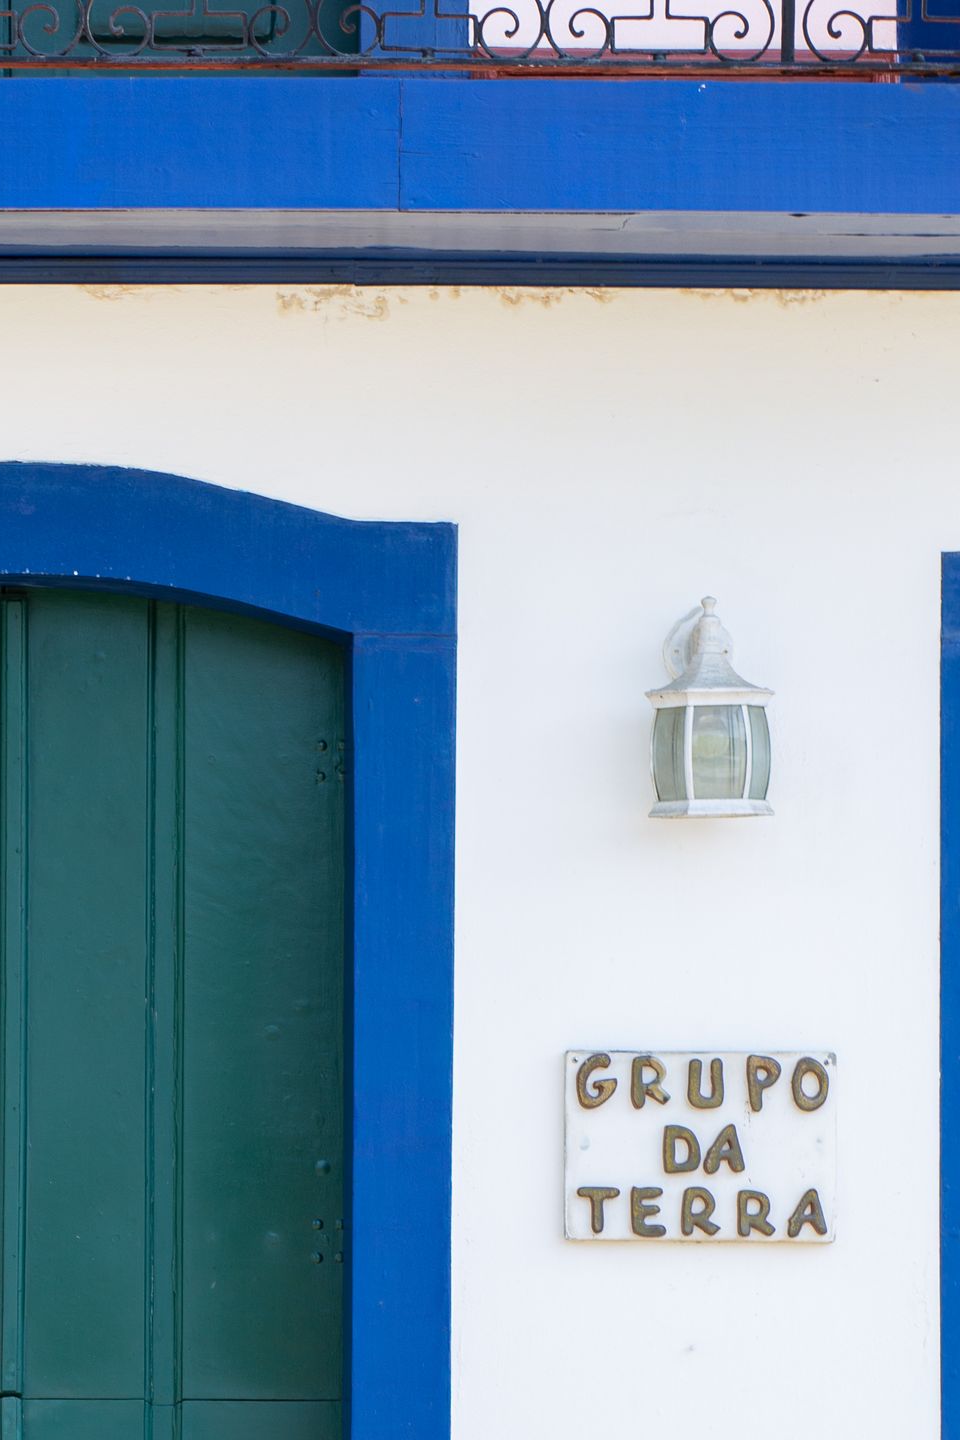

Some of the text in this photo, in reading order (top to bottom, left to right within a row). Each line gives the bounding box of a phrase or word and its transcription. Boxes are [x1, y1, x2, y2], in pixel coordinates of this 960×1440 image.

[576, 1053, 829, 1112] GRUPO
[663, 1123, 745, 1174] DA
[576, 1186, 827, 1238] TERRA
